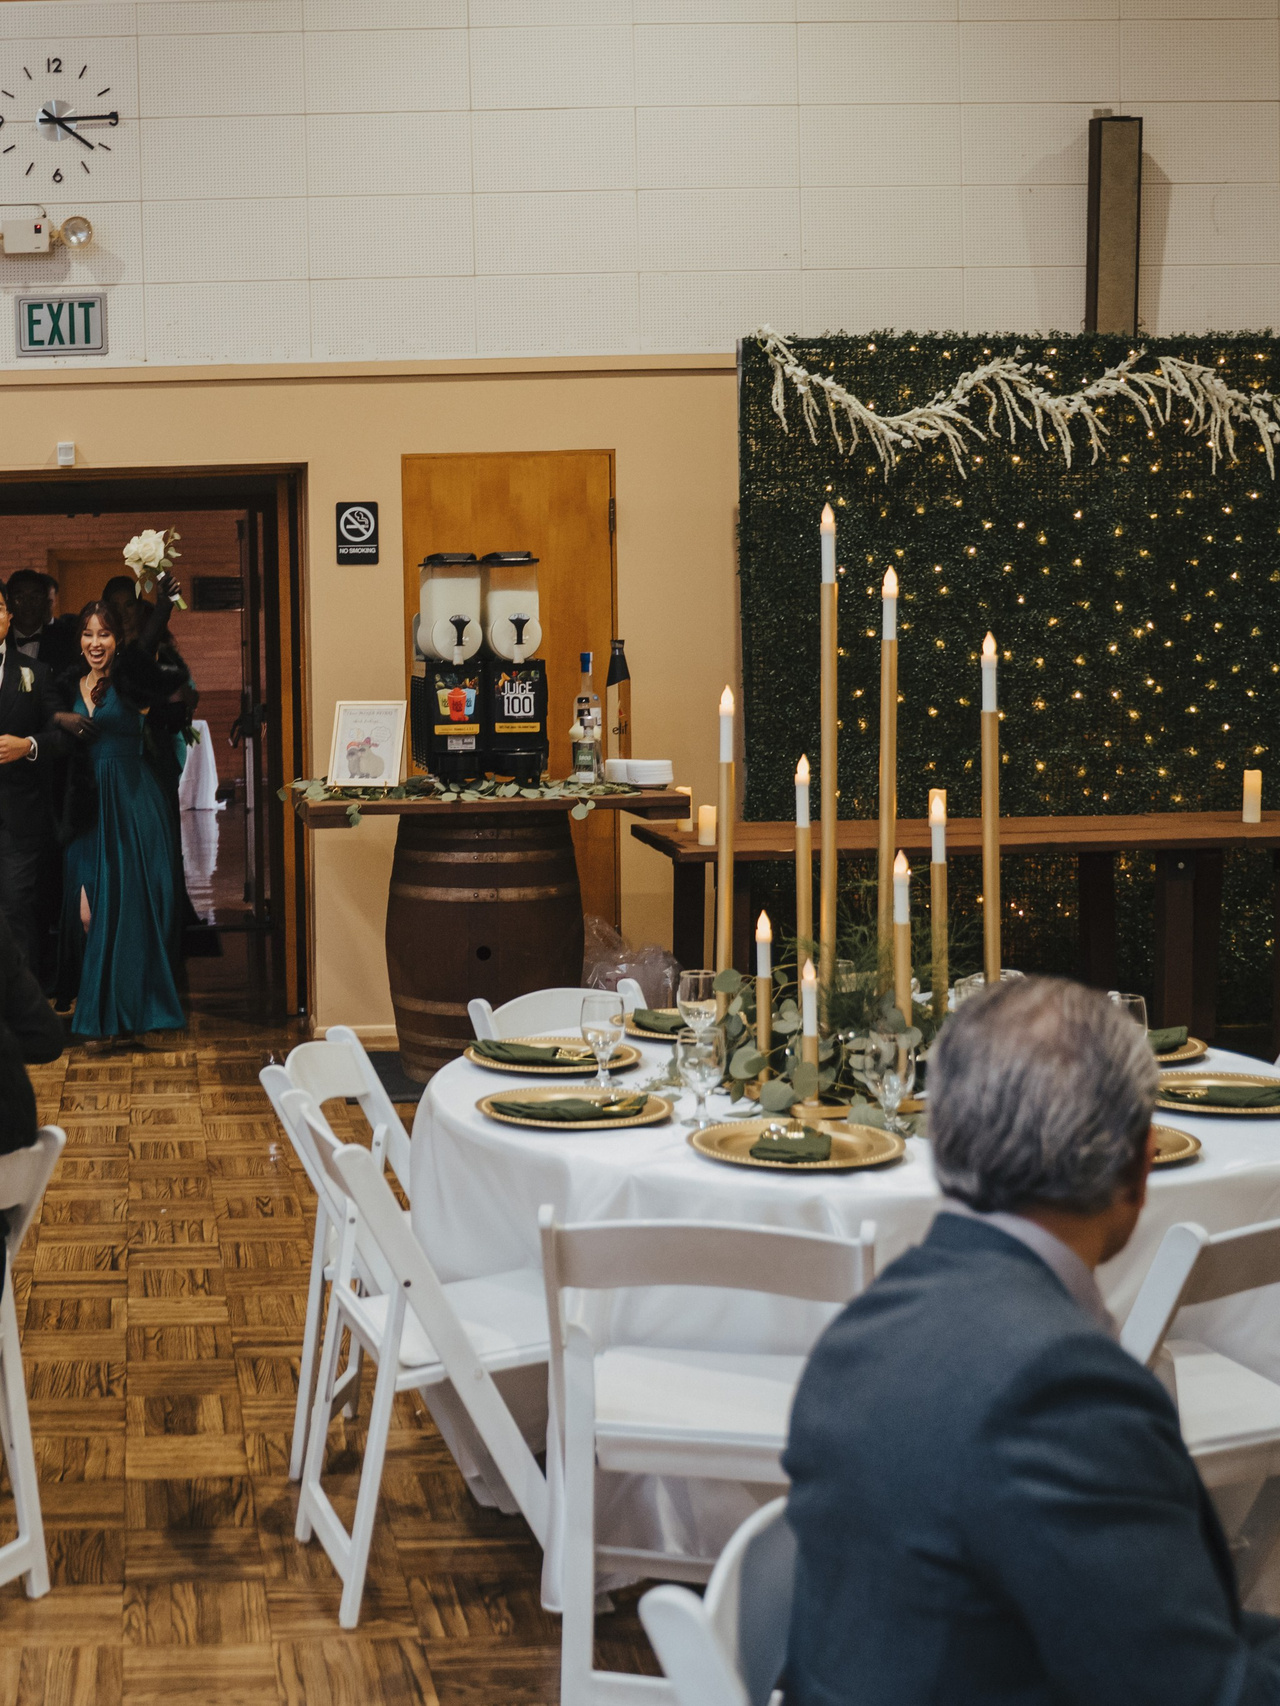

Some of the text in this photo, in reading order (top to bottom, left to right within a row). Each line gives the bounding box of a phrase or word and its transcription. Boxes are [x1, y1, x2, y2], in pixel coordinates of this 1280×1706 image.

[47, 58, 62, 73] 12
[53, 168, 63, 183] 6
[27, 302, 95, 346] EXIT
[501, 681, 536, 696] JUICE
[506, 695, 532, 714] 100
